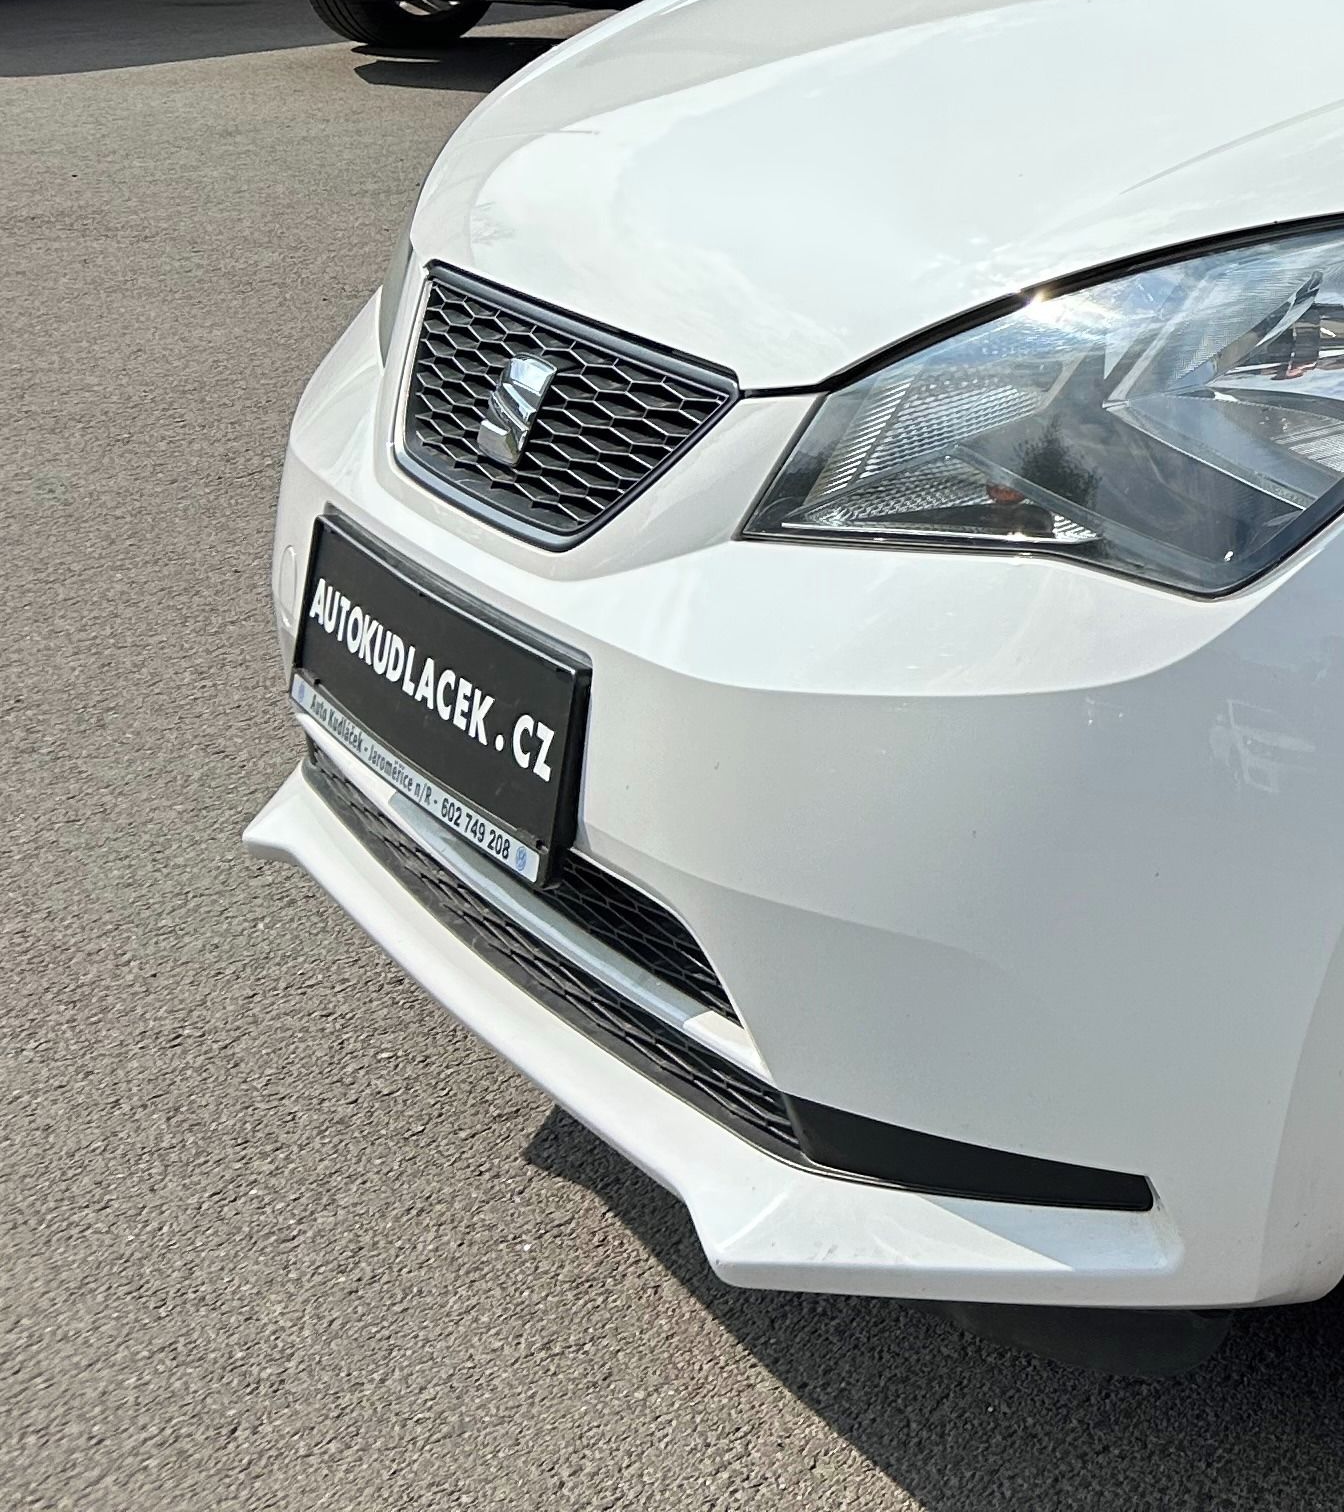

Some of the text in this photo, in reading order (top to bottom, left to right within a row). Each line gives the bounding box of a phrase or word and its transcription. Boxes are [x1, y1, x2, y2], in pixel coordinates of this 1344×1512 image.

[309, 694, 328, 721] Auto
[440, 797, 463, 827] 602
[463, 813, 486, 843] 749
[486, 829, 512, 859] 208
